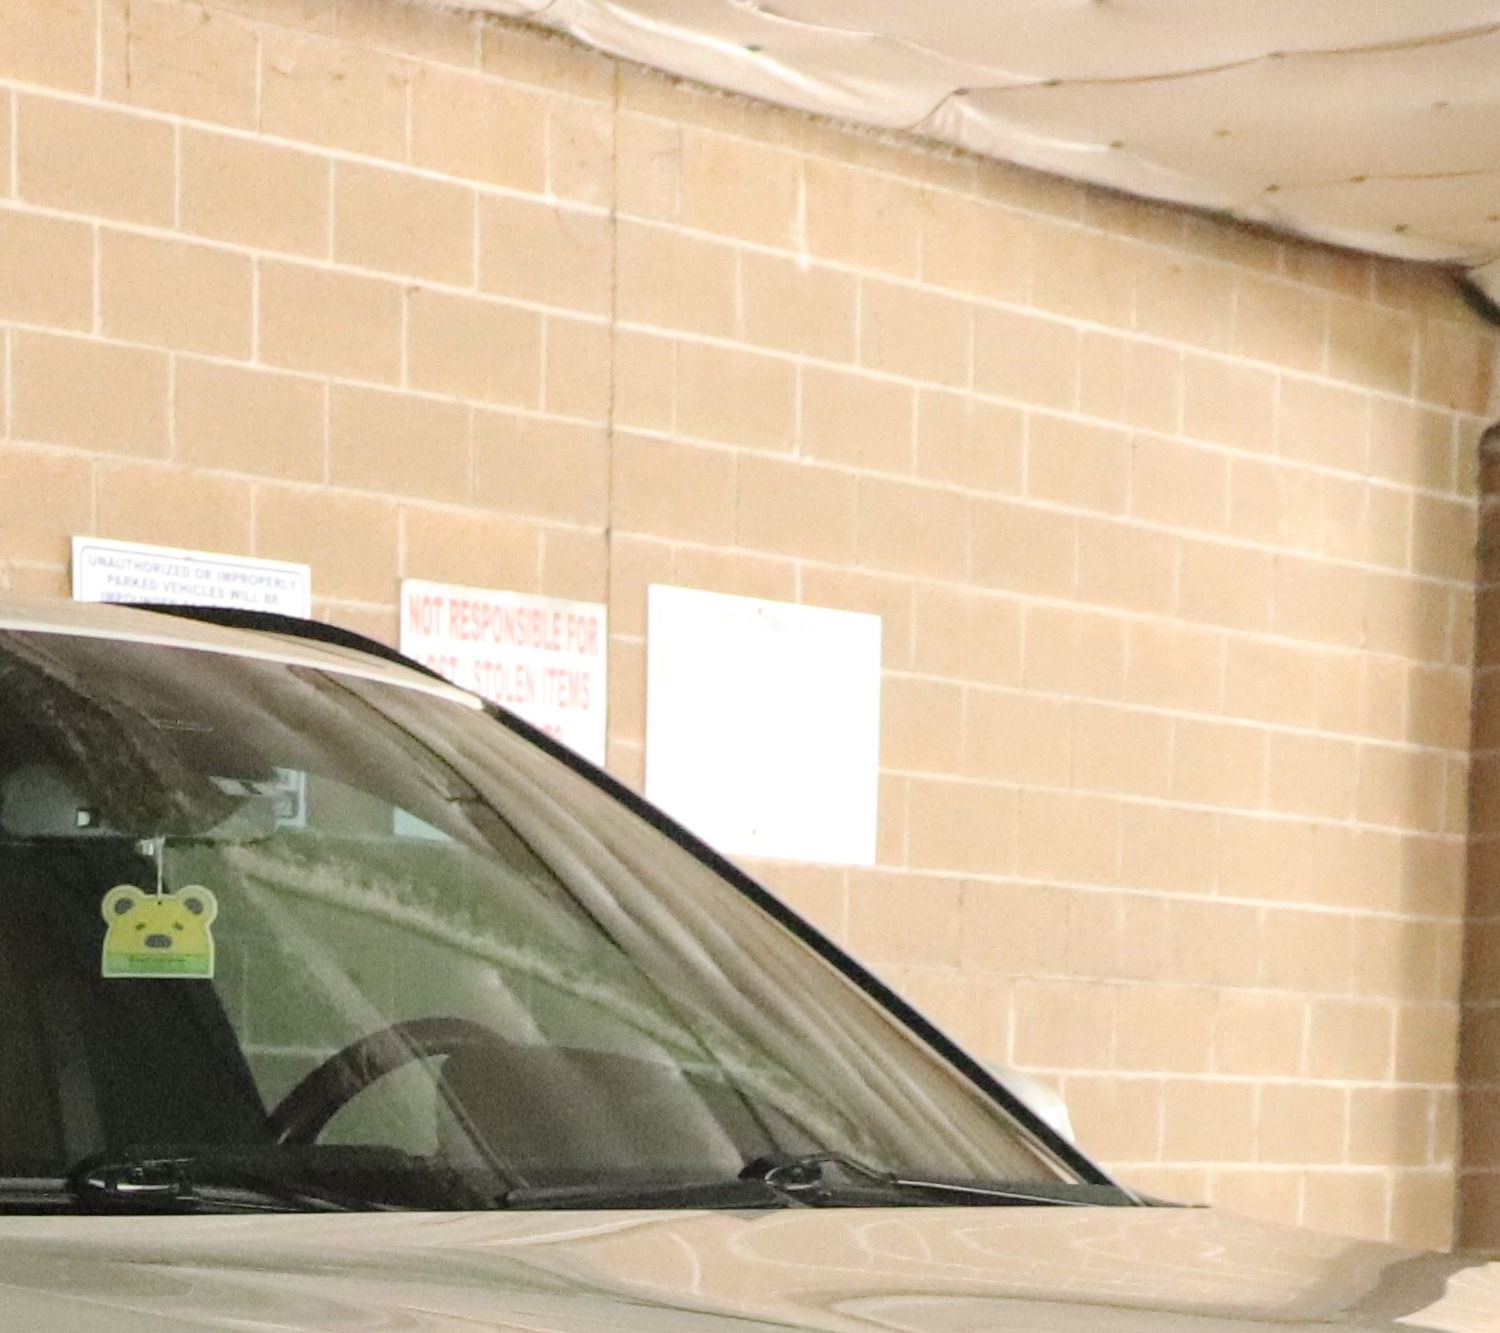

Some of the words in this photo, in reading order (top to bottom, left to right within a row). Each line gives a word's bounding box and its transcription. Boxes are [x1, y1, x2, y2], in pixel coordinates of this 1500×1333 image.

[88, 555, 190, 577] UNAUTHORIZED
[195, 568, 212, 580] OR
[217, 570, 297, 590] IMPROPERLY
[107, 574, 158, 591] PARKED
[163, 581, 224, 599] VEHICLES
[230, 589, 258, 603] WILL
[264, 593, 278, 605] BE
[409, 595, 443, 636] NOT
[449, 598, 561, 652] RESPONSIBLE
[567, 613, 599, 656] FOR
[474, 659, 535, 704] STOLEN
[543, 667, 590, 710] ITEMS
